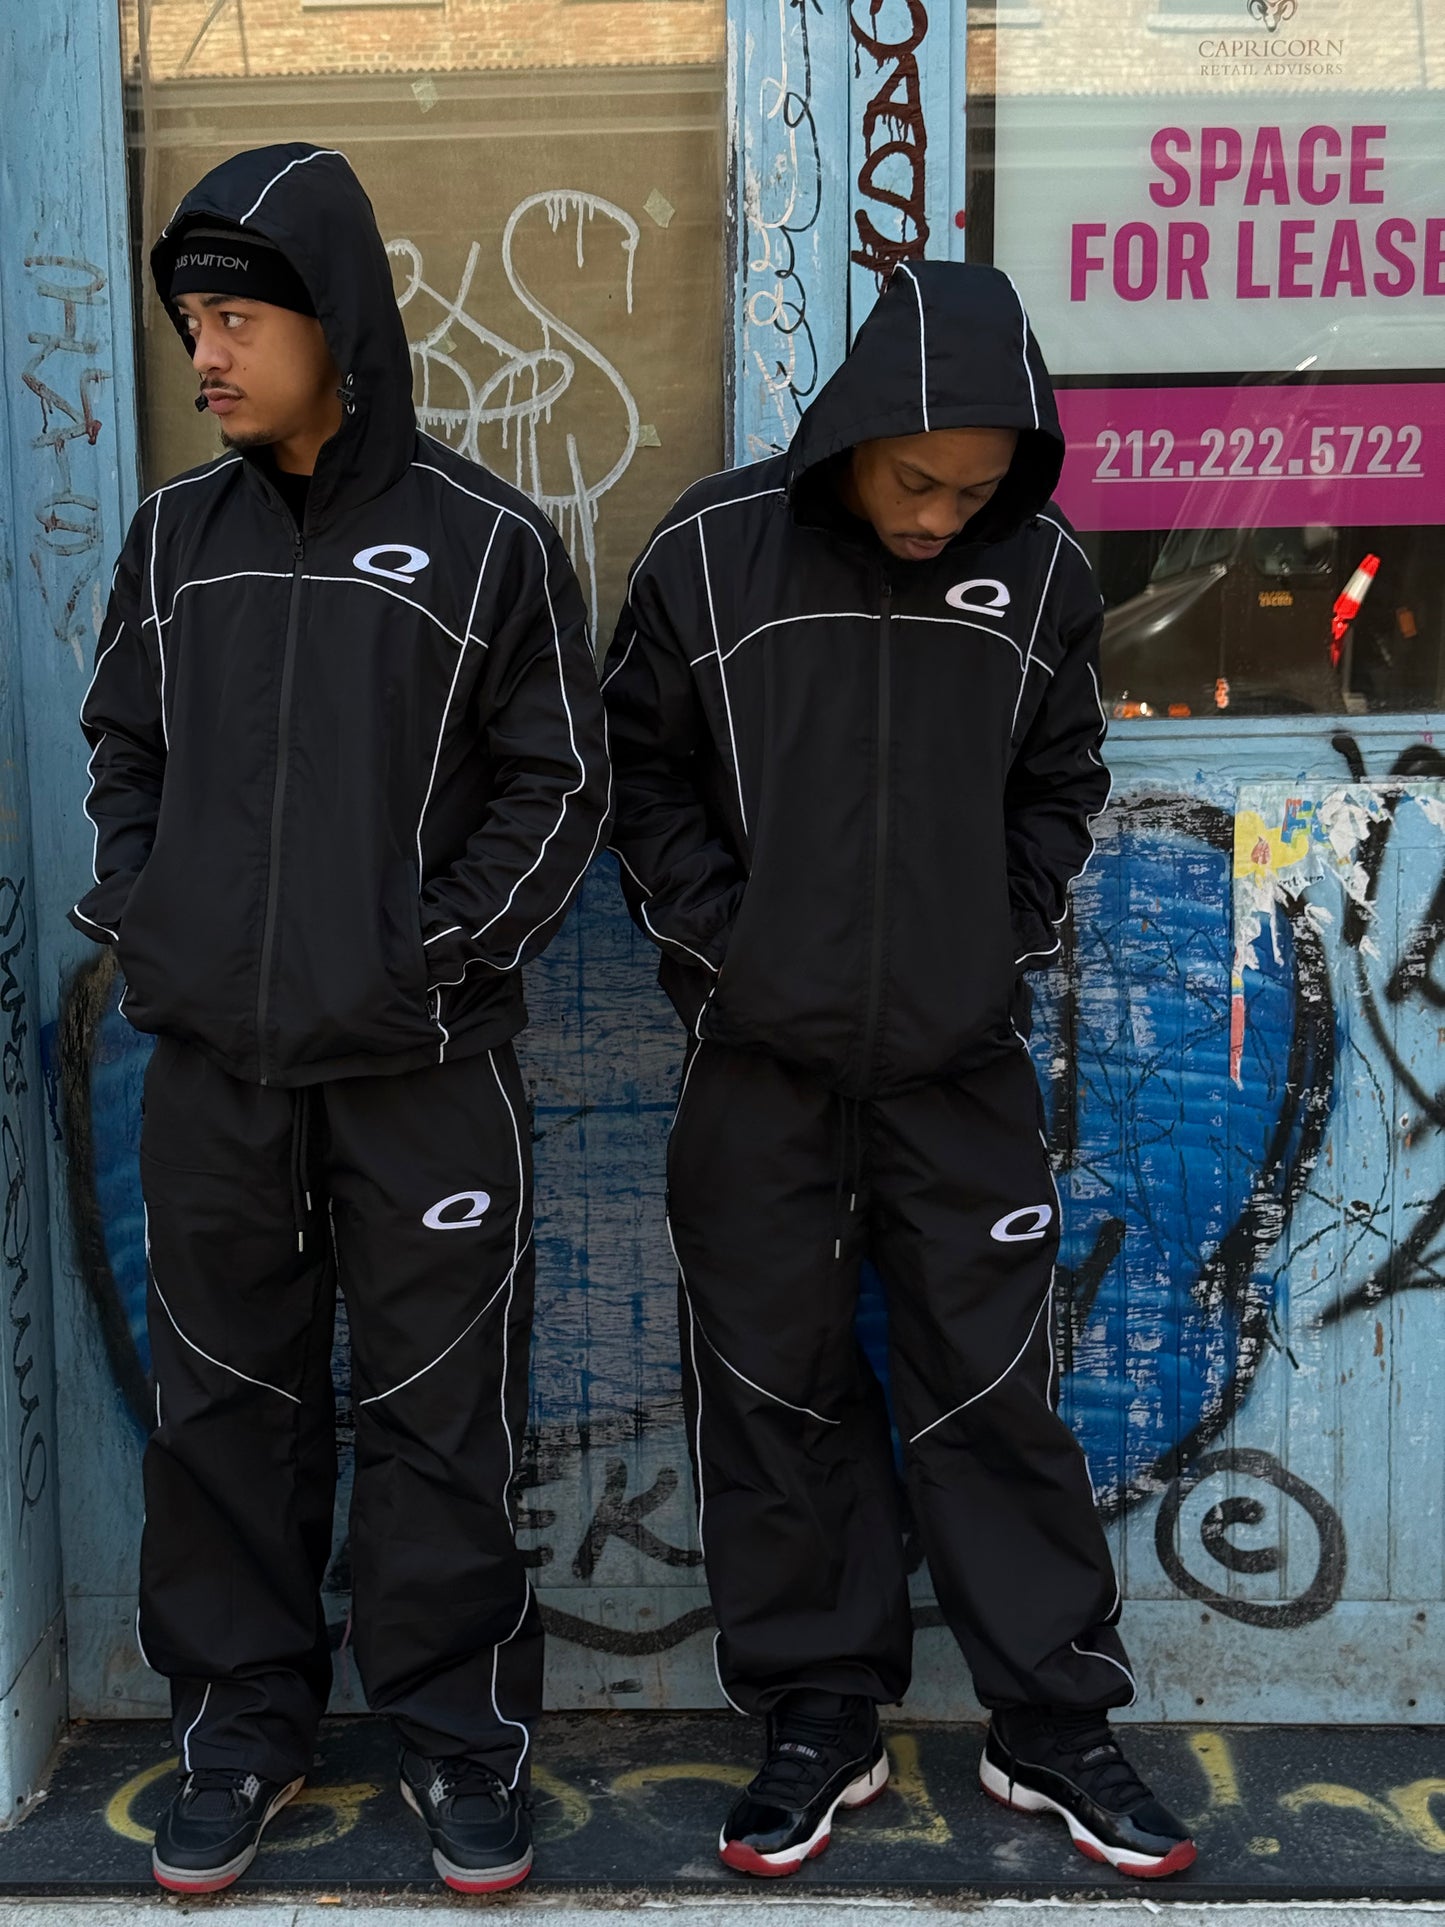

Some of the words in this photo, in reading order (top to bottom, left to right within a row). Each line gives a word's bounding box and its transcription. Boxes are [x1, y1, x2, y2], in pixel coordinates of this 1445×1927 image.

[1198, 39, 1344, 58] CAPRICORN
[1200, 64, 1258, 76] RETAIL
[1263, 63, 1343, 76] ADVISORS
[1148, 125, 1386, 208] SPACE
[189, 253, 250, 272] VUITTON
[1069, 221, 1210, 302] FOR
[1235, 217, 1445, 300] LEASE
[1094, 425, 1423, 479] 212.222.5722
